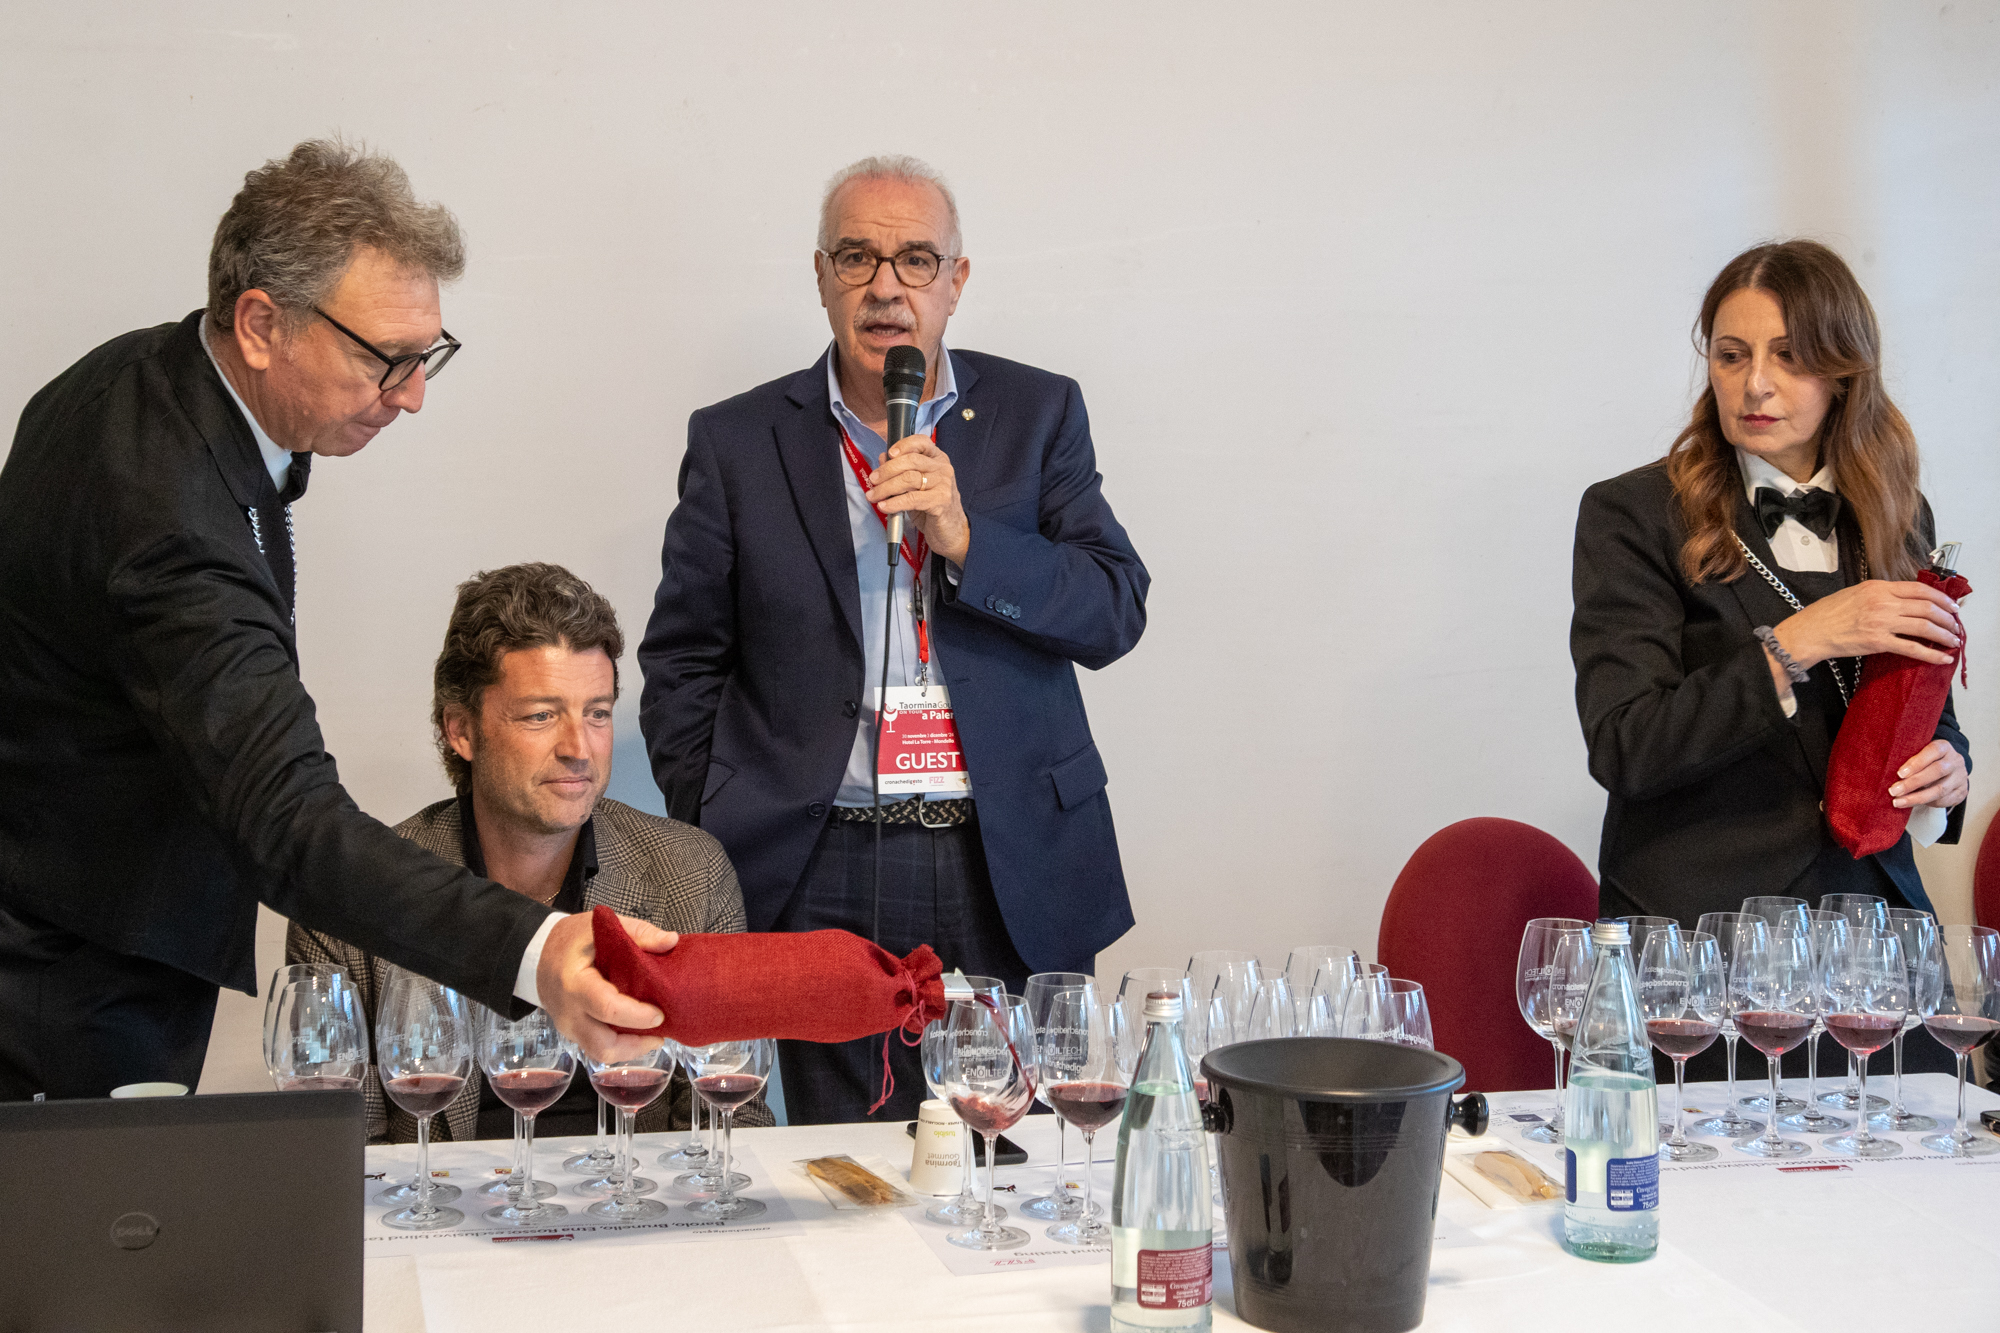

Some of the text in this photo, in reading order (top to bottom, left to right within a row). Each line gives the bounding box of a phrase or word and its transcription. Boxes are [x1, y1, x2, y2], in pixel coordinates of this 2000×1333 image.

[922, 712, 928, 720] a
[895, 751, 960, 770] GUEST
[929, 776, 945, 784] FIZZ
[925, 1160, 962, 1169] Taormina
[600, 1223, 668, 1231] Brunello,
